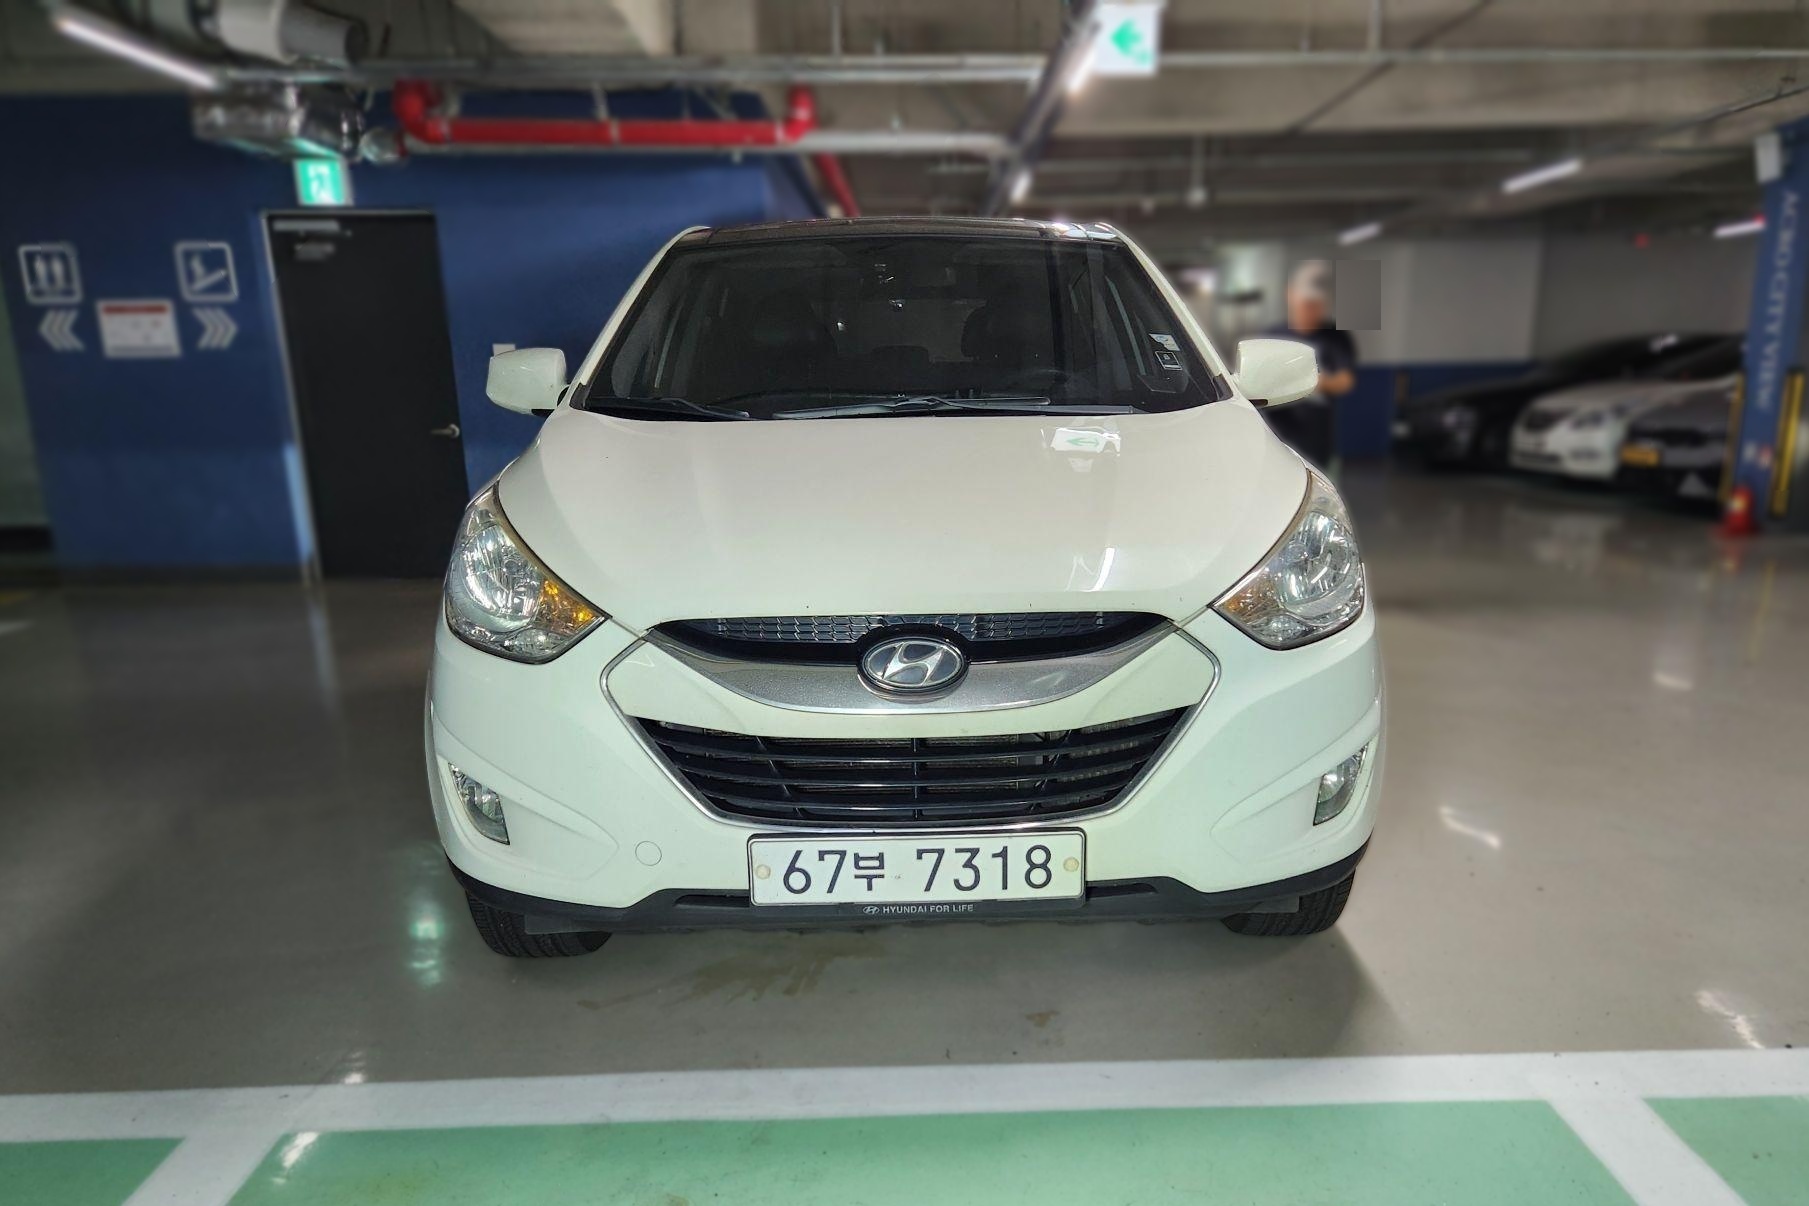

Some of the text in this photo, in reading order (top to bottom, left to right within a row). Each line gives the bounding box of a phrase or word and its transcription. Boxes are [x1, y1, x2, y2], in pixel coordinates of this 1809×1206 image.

[1765, 271, 1790, 336] CITY
[1756, 340, 1781, 412] VIEW
[783, 844, 1053, 894] 67부 7318
[882, 904, 974, 914] HYUNDAI FOR LIFE
